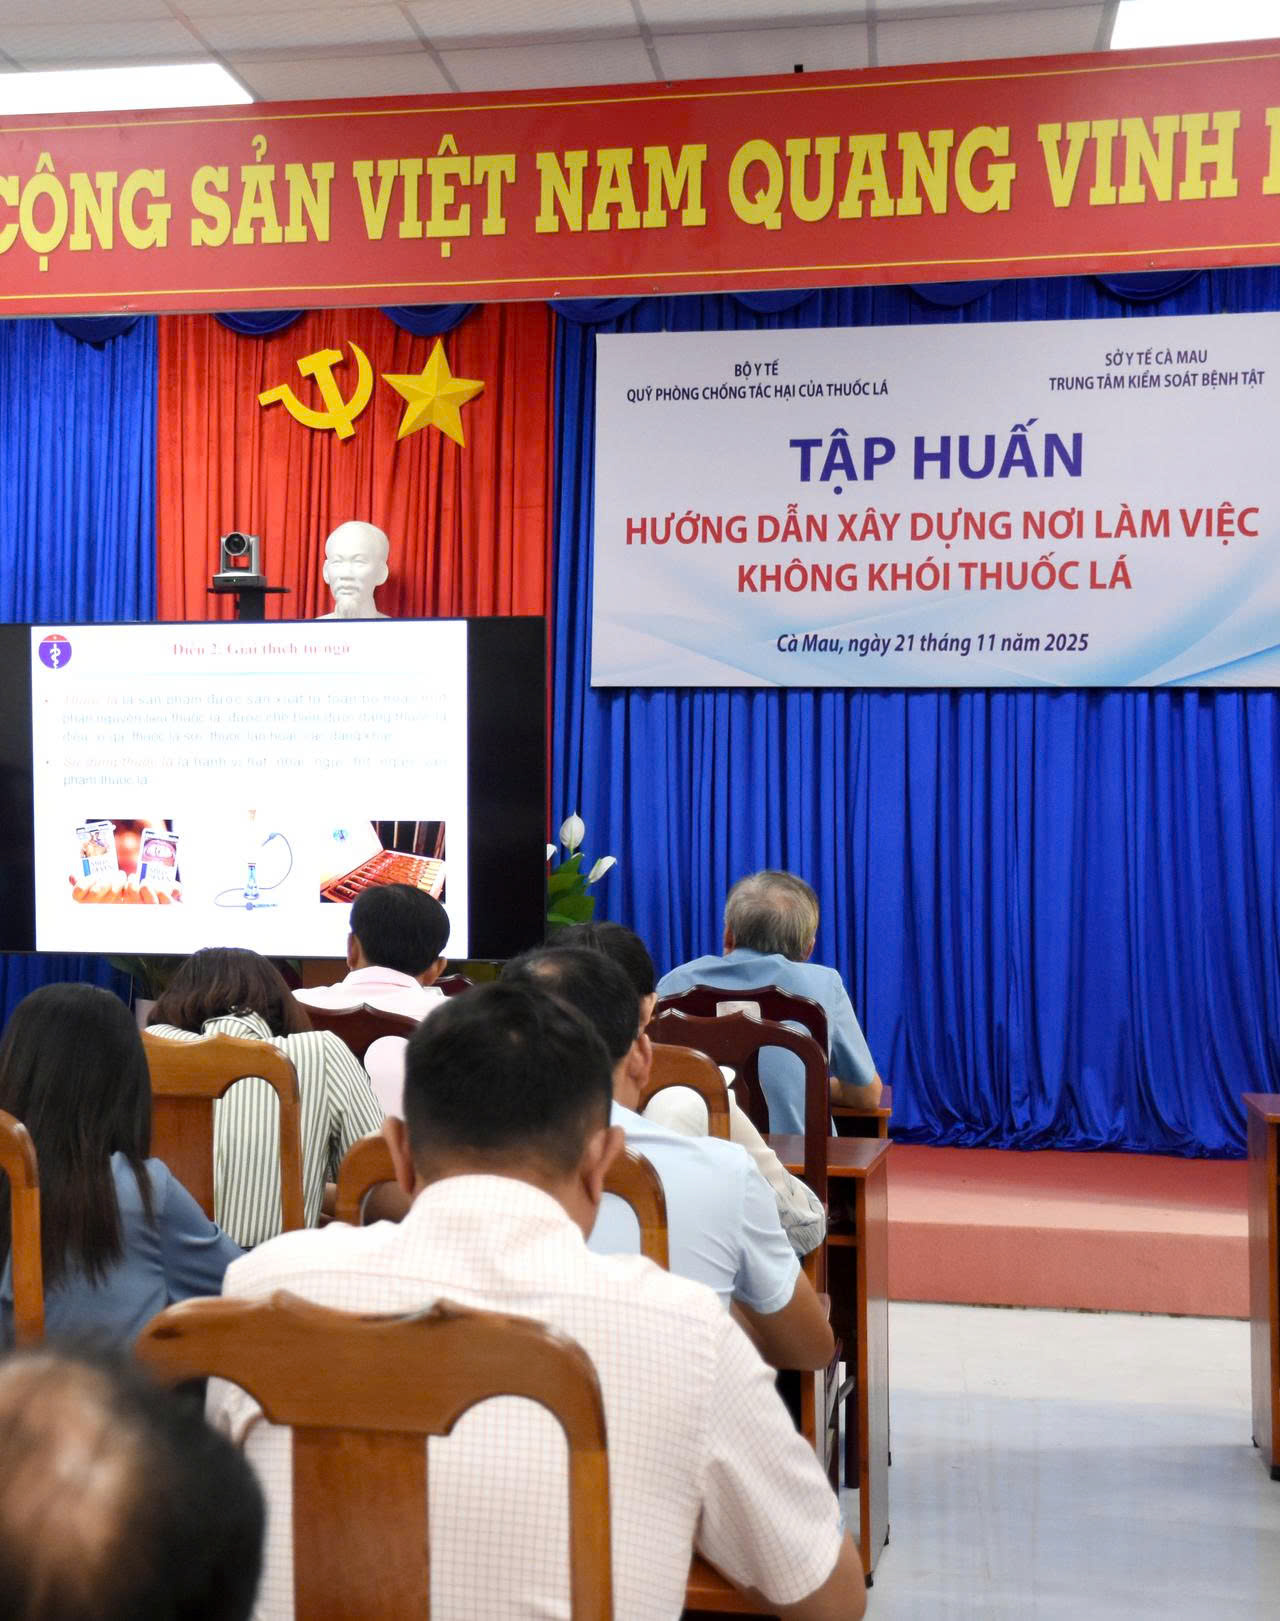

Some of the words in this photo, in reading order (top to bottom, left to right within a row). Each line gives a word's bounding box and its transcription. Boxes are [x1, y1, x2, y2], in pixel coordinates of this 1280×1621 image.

[191, 135, 335, 247] SẢN
[352, 134, 516, 257] VIỆT
[535, 143, 707, 233] NAM
[728, 125, 1017, 230] QUANG
[1037, 111, 1241, 208] VINH
[734, 360, 752, 381] BỘ
[753, 362, 763, 377] Y
[763, 358, 780, 377] TẾ
[1105, 348, 1124, 367] SỞ
[1125, 351, 1134, 366] Y
[1135, 347, 1153, 366] TẾ
[1154, 347, 1174, 366] CÀ
[1176, 349, 1208, 364] MAU
[626, 385, 653, 404] QUỸ
[655, 384, 700, 401] PHÒNG
[701, 381, 747, 401] CHỐNG
[748, 382, 772, 399] TÁC
[774, 384, 796, 402] HẠI
[798, 379, 824, 398] CỦA
[825, 378, 871, 397] THUỐC
[872, 378, 889, 396] LÁ
[1048, 375, 1095, 391] TRUNG
[1096, 372, 1125, 390] TÂM
[1128, 369, 1161, 389] KIỂM
[1163, 370, 1200, 388] SOÁT
[1201, 369, 1239, 390] BỆNH
[1240, 368, 1266, 389] TẬT
[788, 427, 896, 496] TẬP
[913, 417, 1083, 481] HUẤN
[626, 511, 748, 545] HƯỚNG
[757, 503, 830, 543] DẪN
[838, 507, 901, 542] XÂY
[910, 507, 1013, 549] DỰNG
[1023, 507, 1085, 540] NƠI
[1095, 503, 1172, 539] LÀM
[1179, 501, 1260, 545] VIỆC
[737, 557, 859, 594] KHÔNG
[867, 556, 951, 593] KHÓI
[958, 552, 1081, 592] THUỐC
[1089, 553, 1133, 591] LÁ
[776, 633, 799, 653] Cà
[801, 633, 844, 655] Mau,
[847, 632, 892, 658] ngày
[893, 633, 915, 652] 21
[919, 632, 972, 657] tháng
[977, 633, 996, 652] 11
[1000, 632, 1041, 652] năm
[1043, 632, 1089, 652] 2025
